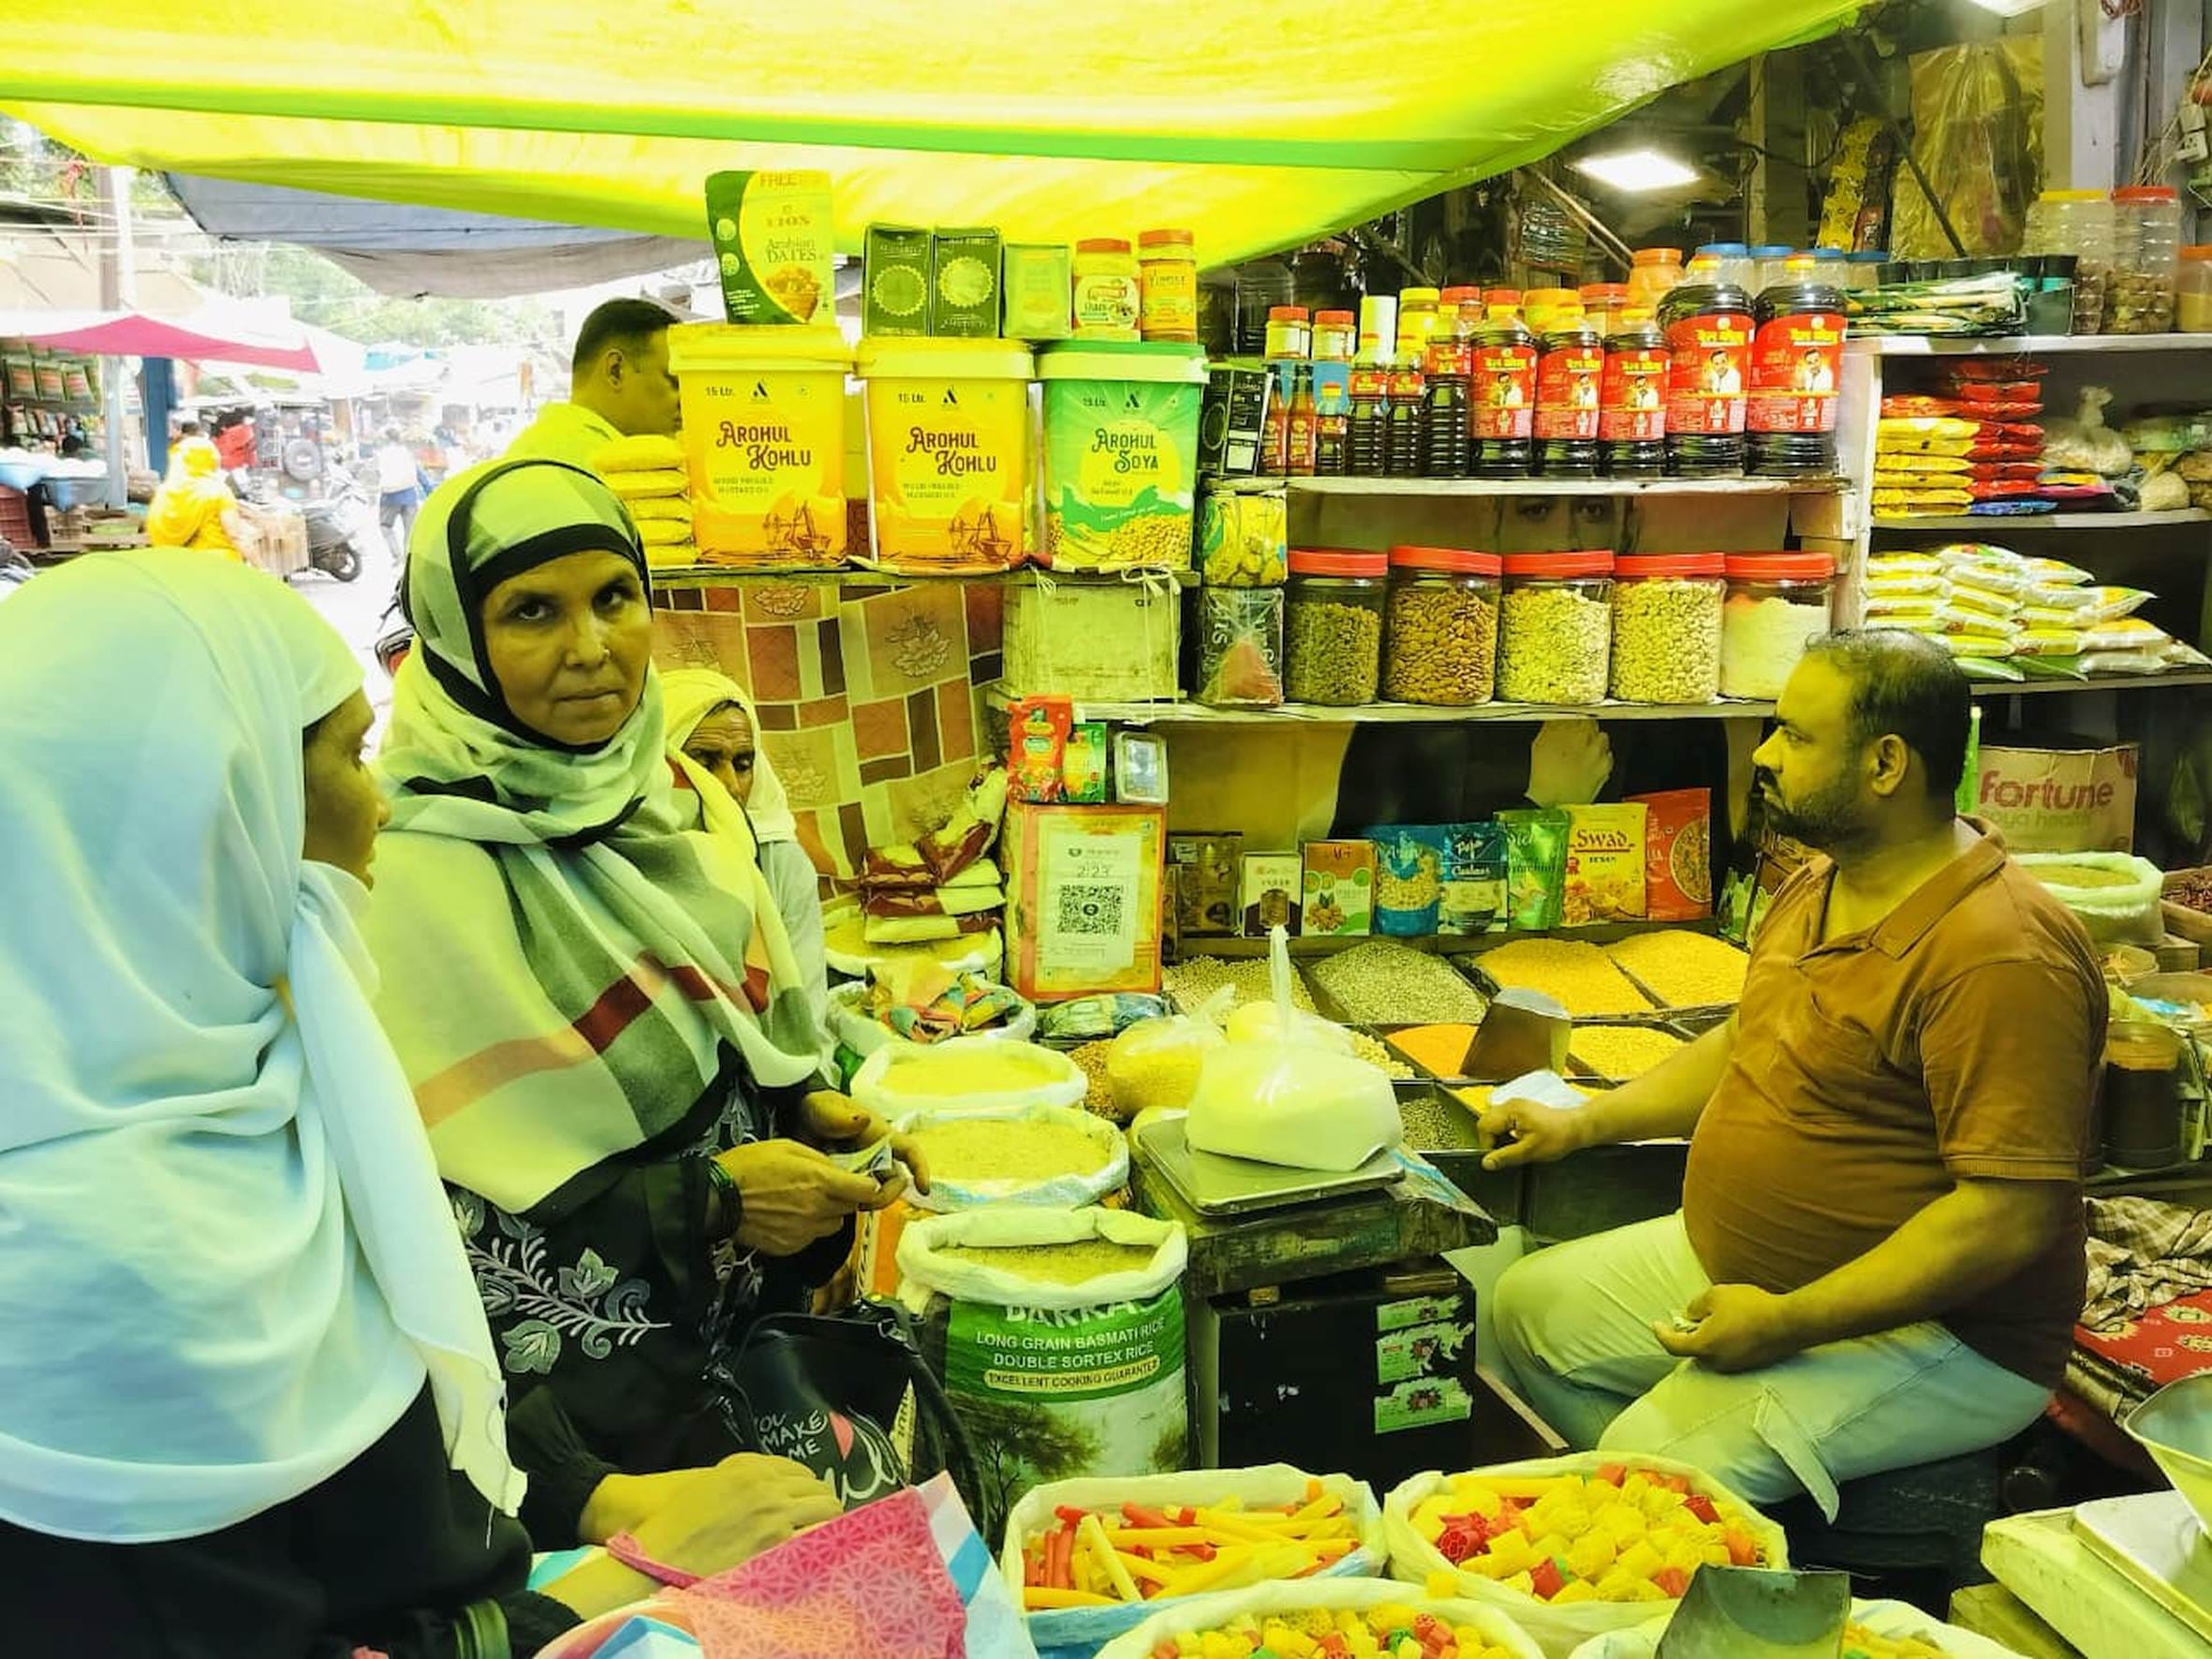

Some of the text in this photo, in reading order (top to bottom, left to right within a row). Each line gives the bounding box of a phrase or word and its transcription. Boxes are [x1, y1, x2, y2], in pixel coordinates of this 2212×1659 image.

[715, 420, 792, 448] AROHUL
[906, 426, 980, 454] AROHUL
[1091, 428, 1158, 453] AROHUL
[746, 444, 812, 471] KOHLU
[935, 449, 996, 477] KOHLU
[1113, 448, 1159, 474] SOYA
[1980, 770, 2114, 810] fortune
[977, 1316, 1165, 1351] LONG GRAIN BASMATI RICE
[993, 1341, 1155, 1370] DOUBLE SORTEX RICE
[988, 1372, 1050, 1387] EXCELLENT
[1052, 1373, 1102, 1387] COOKING
[754, 1412, 787, 1433] OU
[761, 1409, 829, 1452] MAKE
[788, 1437, 822, 1461] ME
